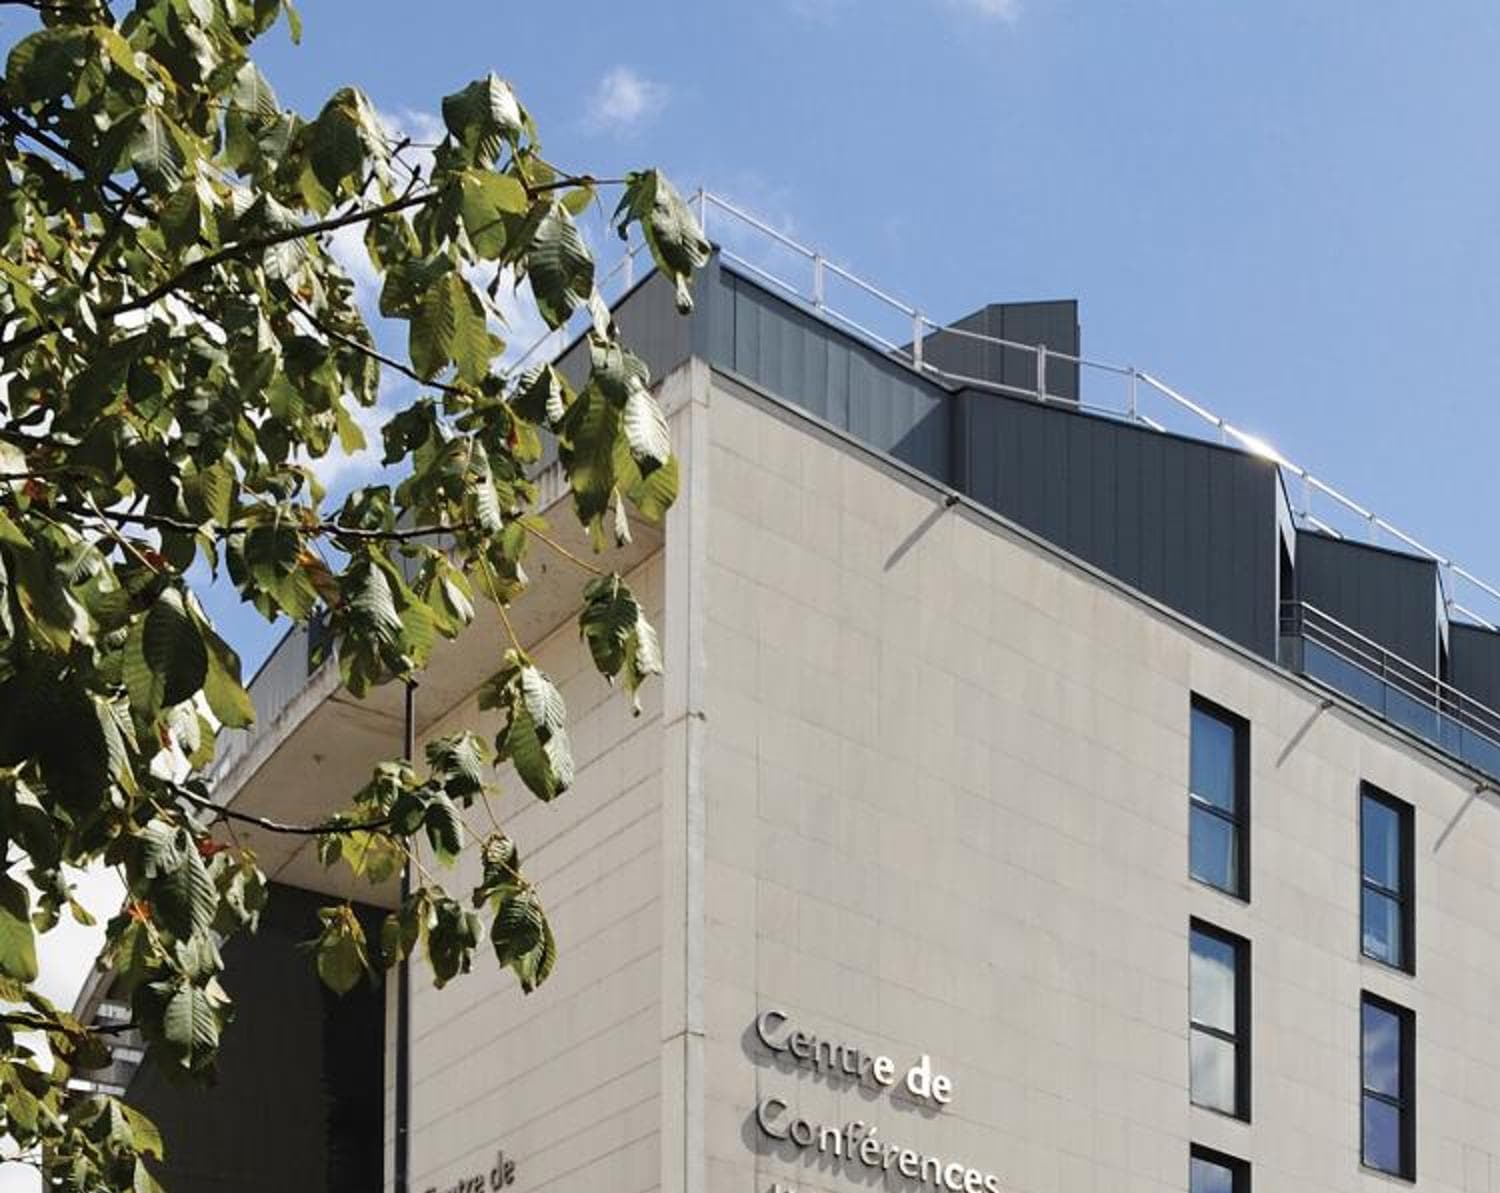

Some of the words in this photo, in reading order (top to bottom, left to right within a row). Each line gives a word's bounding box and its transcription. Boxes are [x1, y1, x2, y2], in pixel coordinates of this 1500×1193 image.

[755, 1009, 895, 1085] Centre
[906, 1054, 952, 1104] de
[489, 1150, 516, 1190] de
